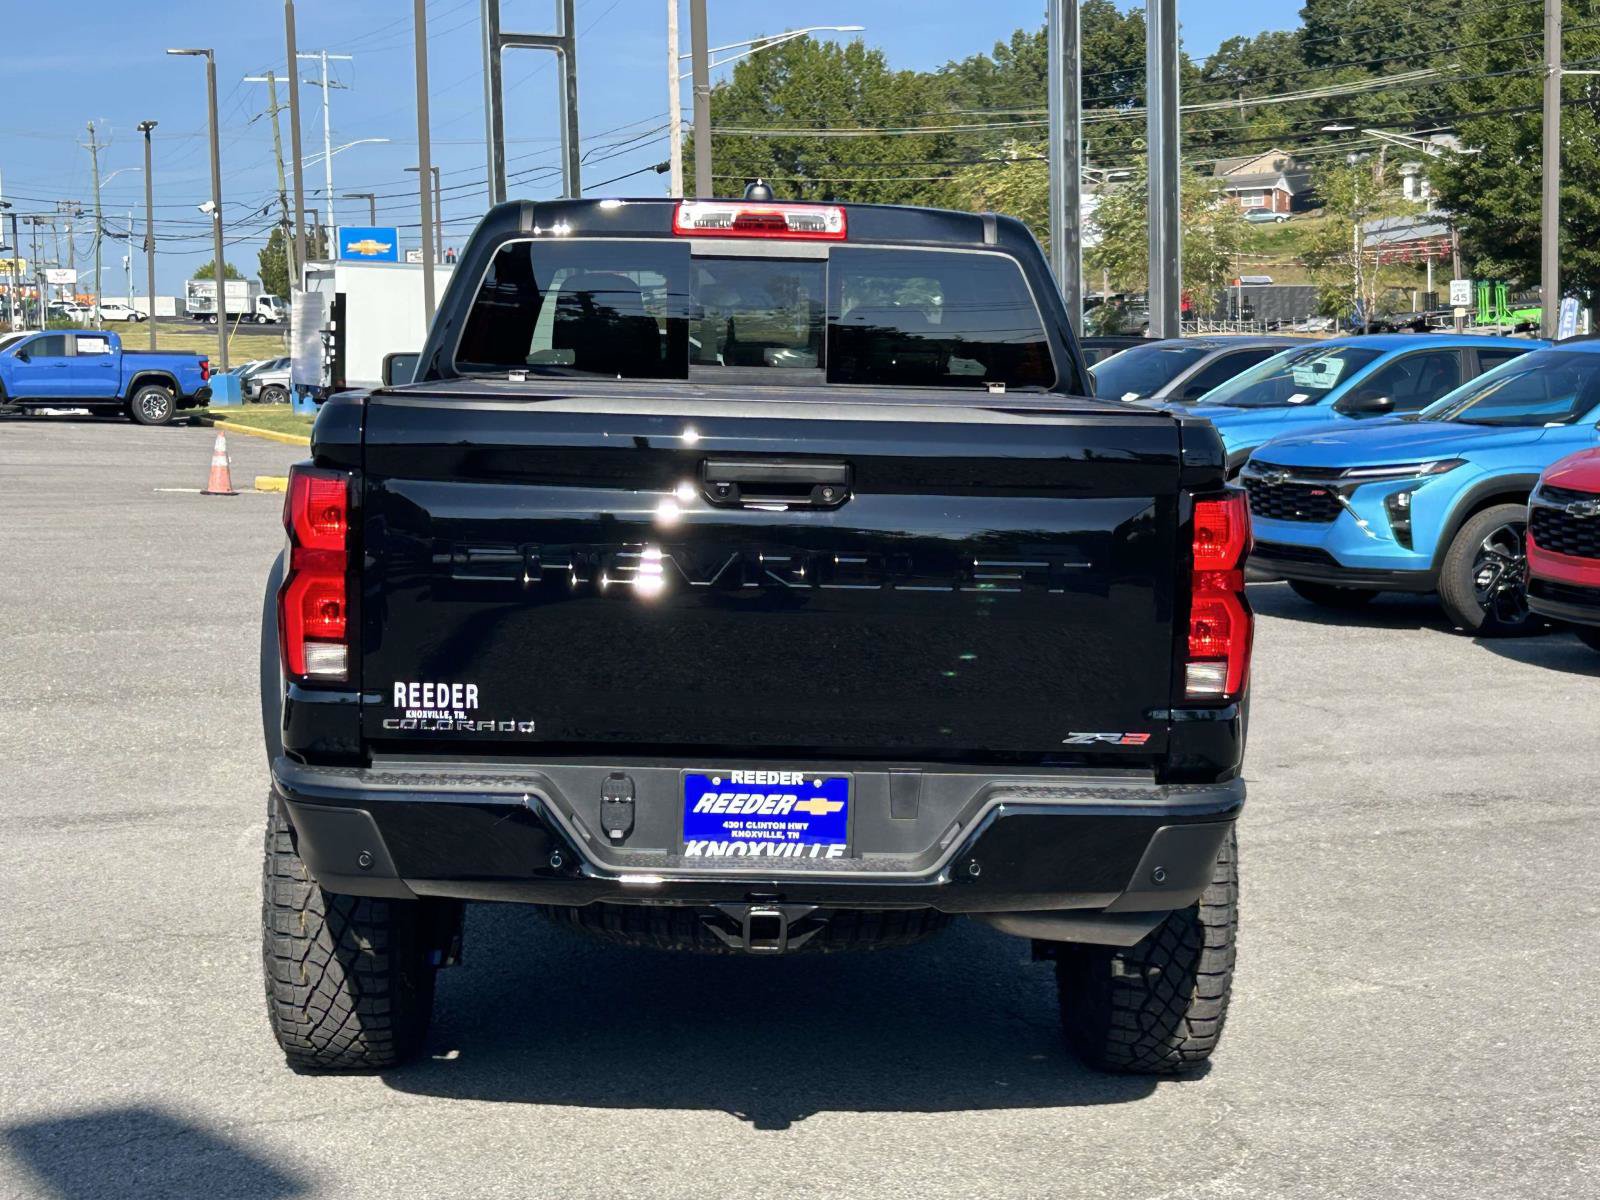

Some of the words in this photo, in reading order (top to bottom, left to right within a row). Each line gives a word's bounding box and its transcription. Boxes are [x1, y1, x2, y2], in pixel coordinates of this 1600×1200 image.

[1453, 293, 1468, 302] 45
[393, 681, 479, 709] REEDER
[382, 718, 536, 733] COLORADO
[1061, 732, 1152, 744] ZR2
[731, 770, 805, 786] REEDER
[692, 792, 798, 815] REEDER
[722, 820, 744, 829] 4301
[745, 821, 787, 830] CLINTON
[787, 822, 809, 831] HWY
[731, 830, 786, 840] KNOXVILLE,
[786, 831, 800, 840] TN
